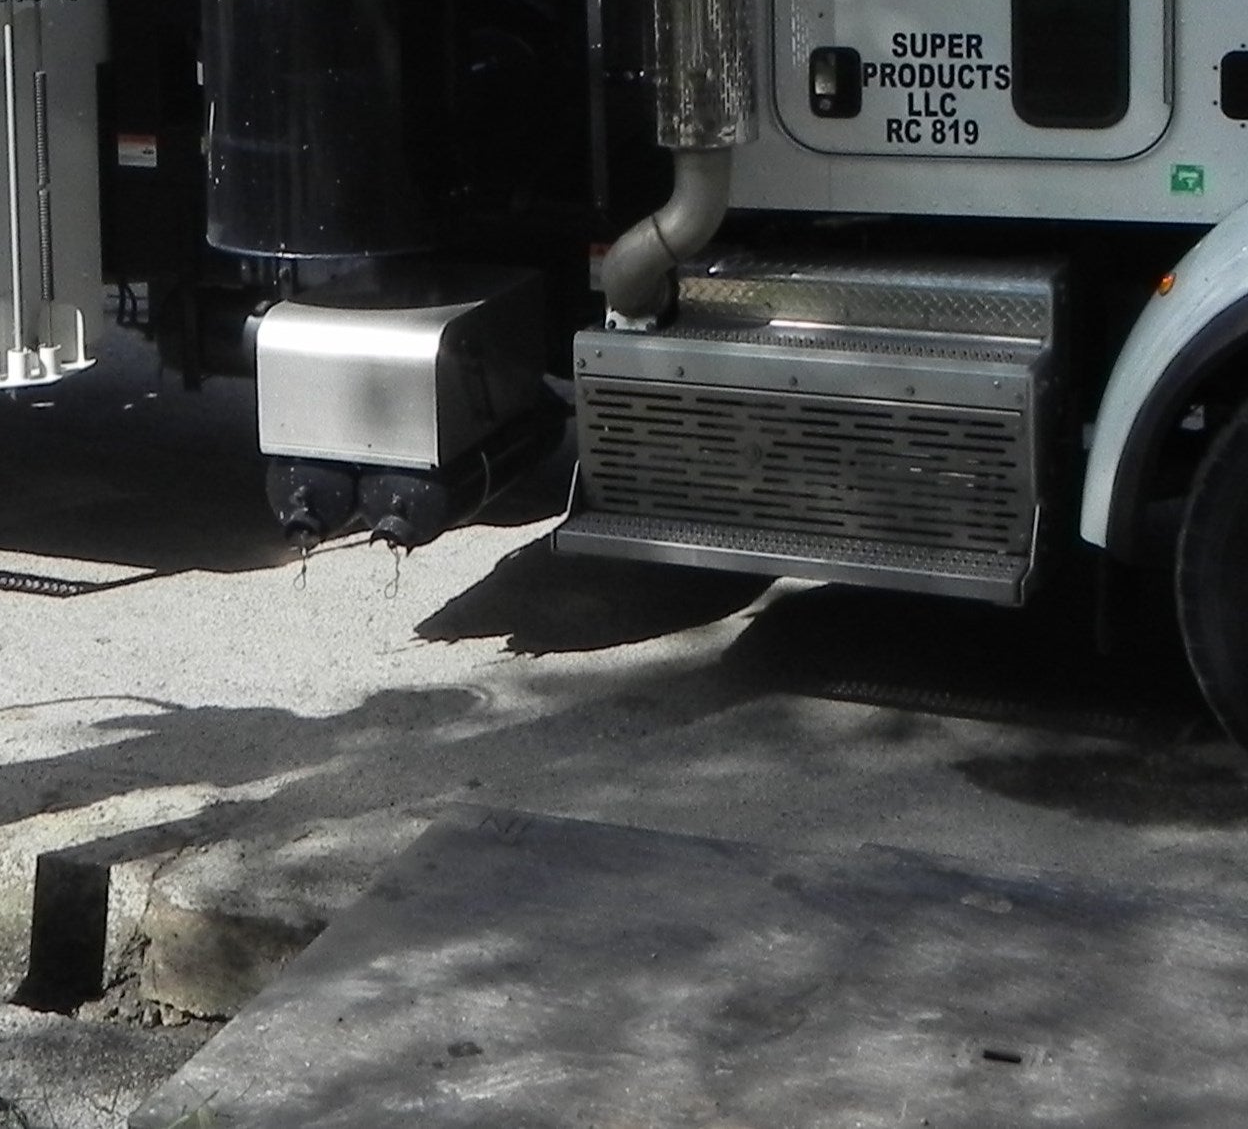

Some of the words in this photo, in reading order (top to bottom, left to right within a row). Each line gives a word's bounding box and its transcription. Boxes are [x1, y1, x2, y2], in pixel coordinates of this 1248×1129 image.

[892, 32, 983, 59] SUPER
[862, 62, 1011, 91] PRODUCTS
[907, 91, 957, 118] LLC
[886, 118, 922, 144] RC
[931, 119, 979, 145] 819
